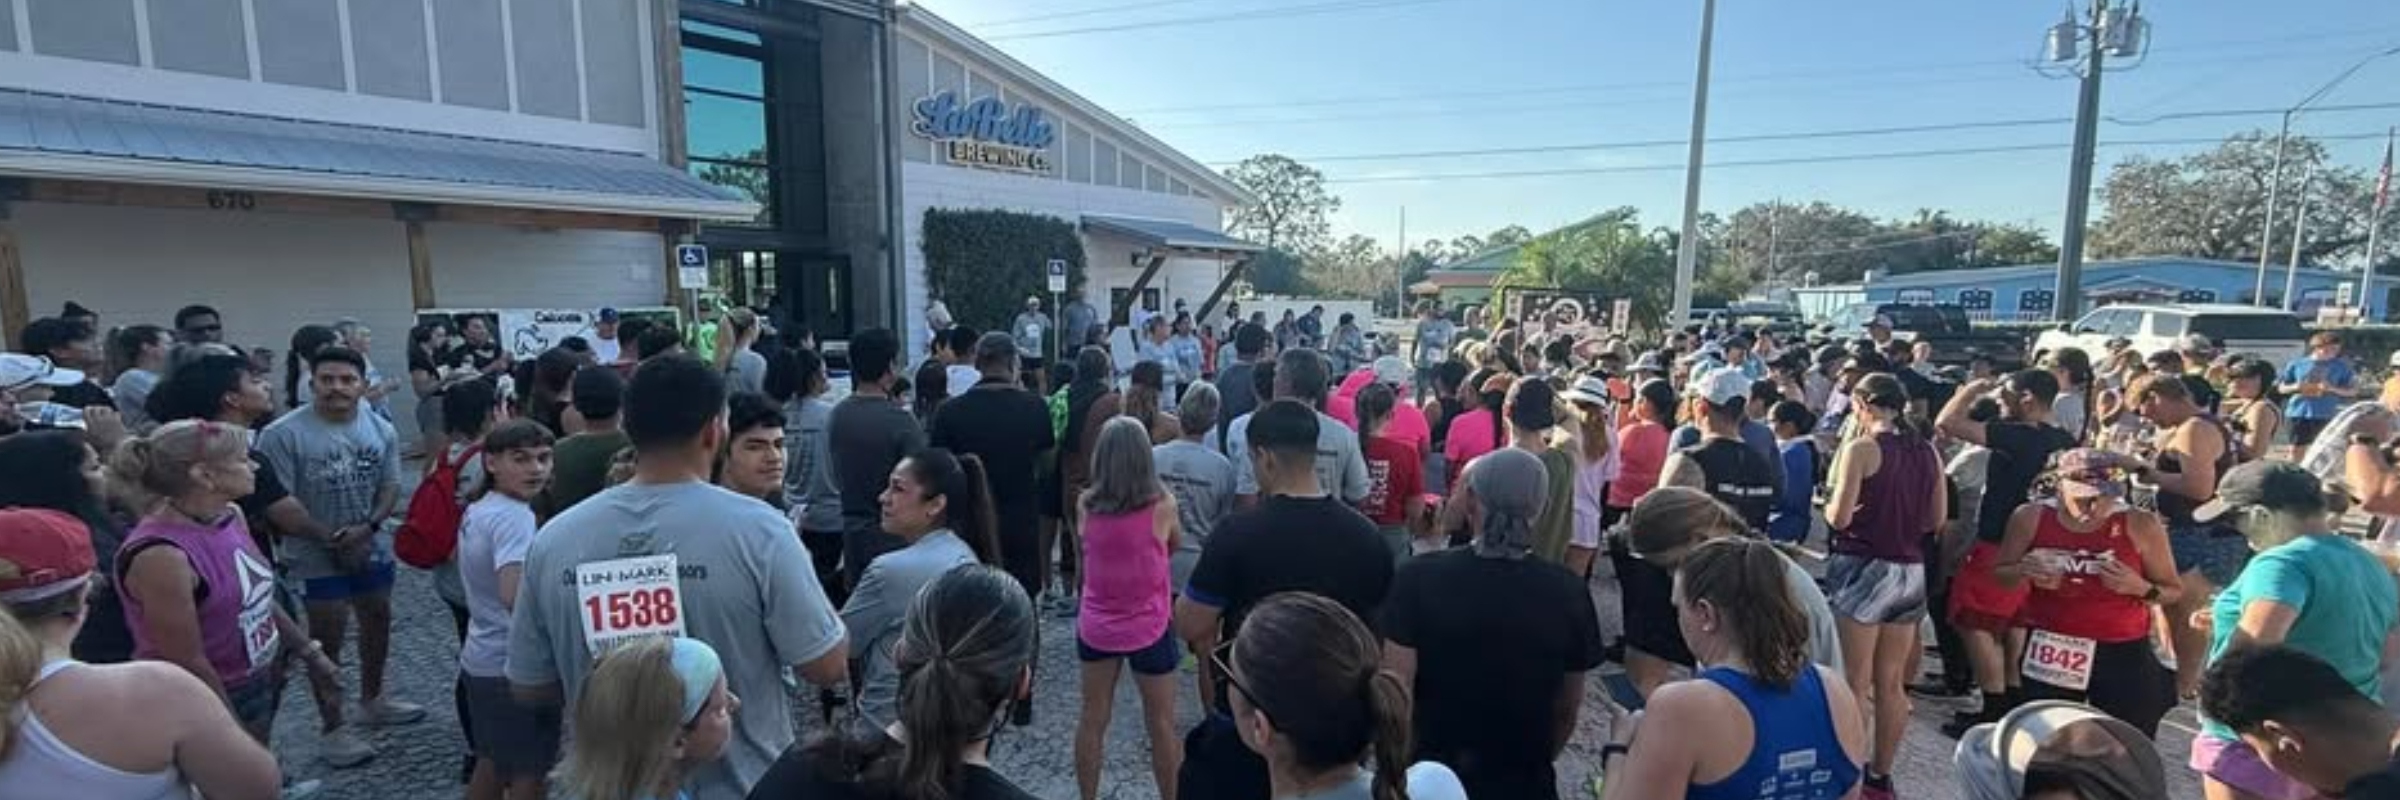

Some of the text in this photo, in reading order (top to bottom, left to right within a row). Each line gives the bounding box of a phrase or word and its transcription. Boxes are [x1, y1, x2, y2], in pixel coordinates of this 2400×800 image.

[950, 140, 1025, 167] BREWING
[208, 190, 256, 210] 670
[585, 587, 677, 632] 1538
[2029, 641, 2089, 673] 1842
